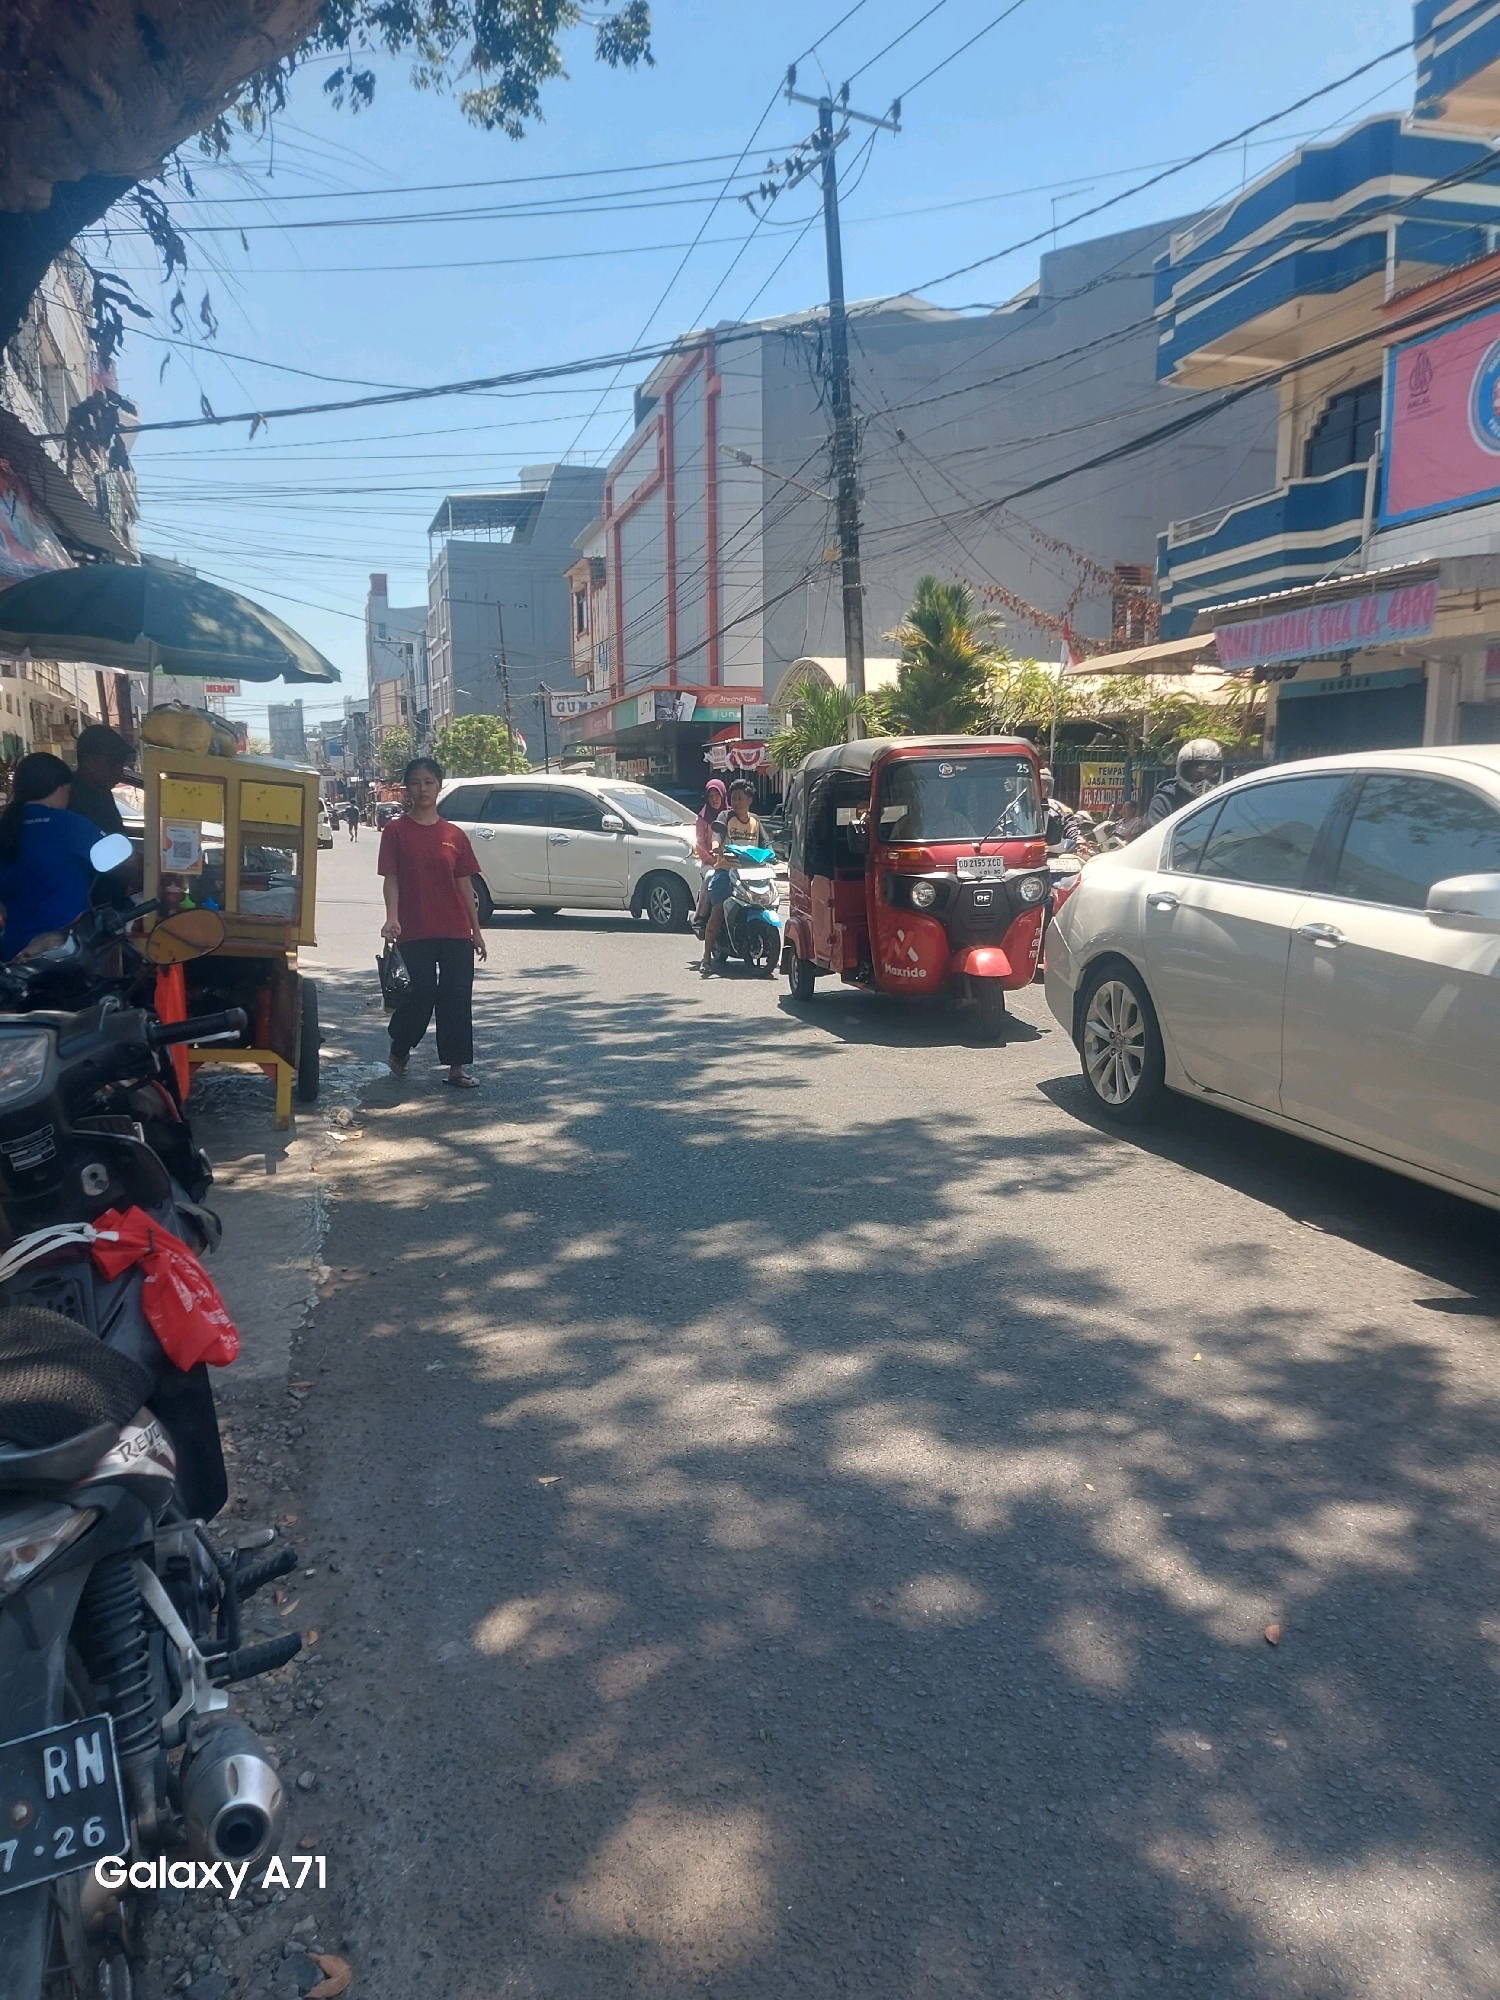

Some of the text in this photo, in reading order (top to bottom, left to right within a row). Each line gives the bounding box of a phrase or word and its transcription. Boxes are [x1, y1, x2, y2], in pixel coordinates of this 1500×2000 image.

[1016, 763, 1030, 774] 25
[1087, 777, 1106, 786] JASA
[884, 963, 927, 978] Maxride
[43, 1731, 105, 1799] RN
